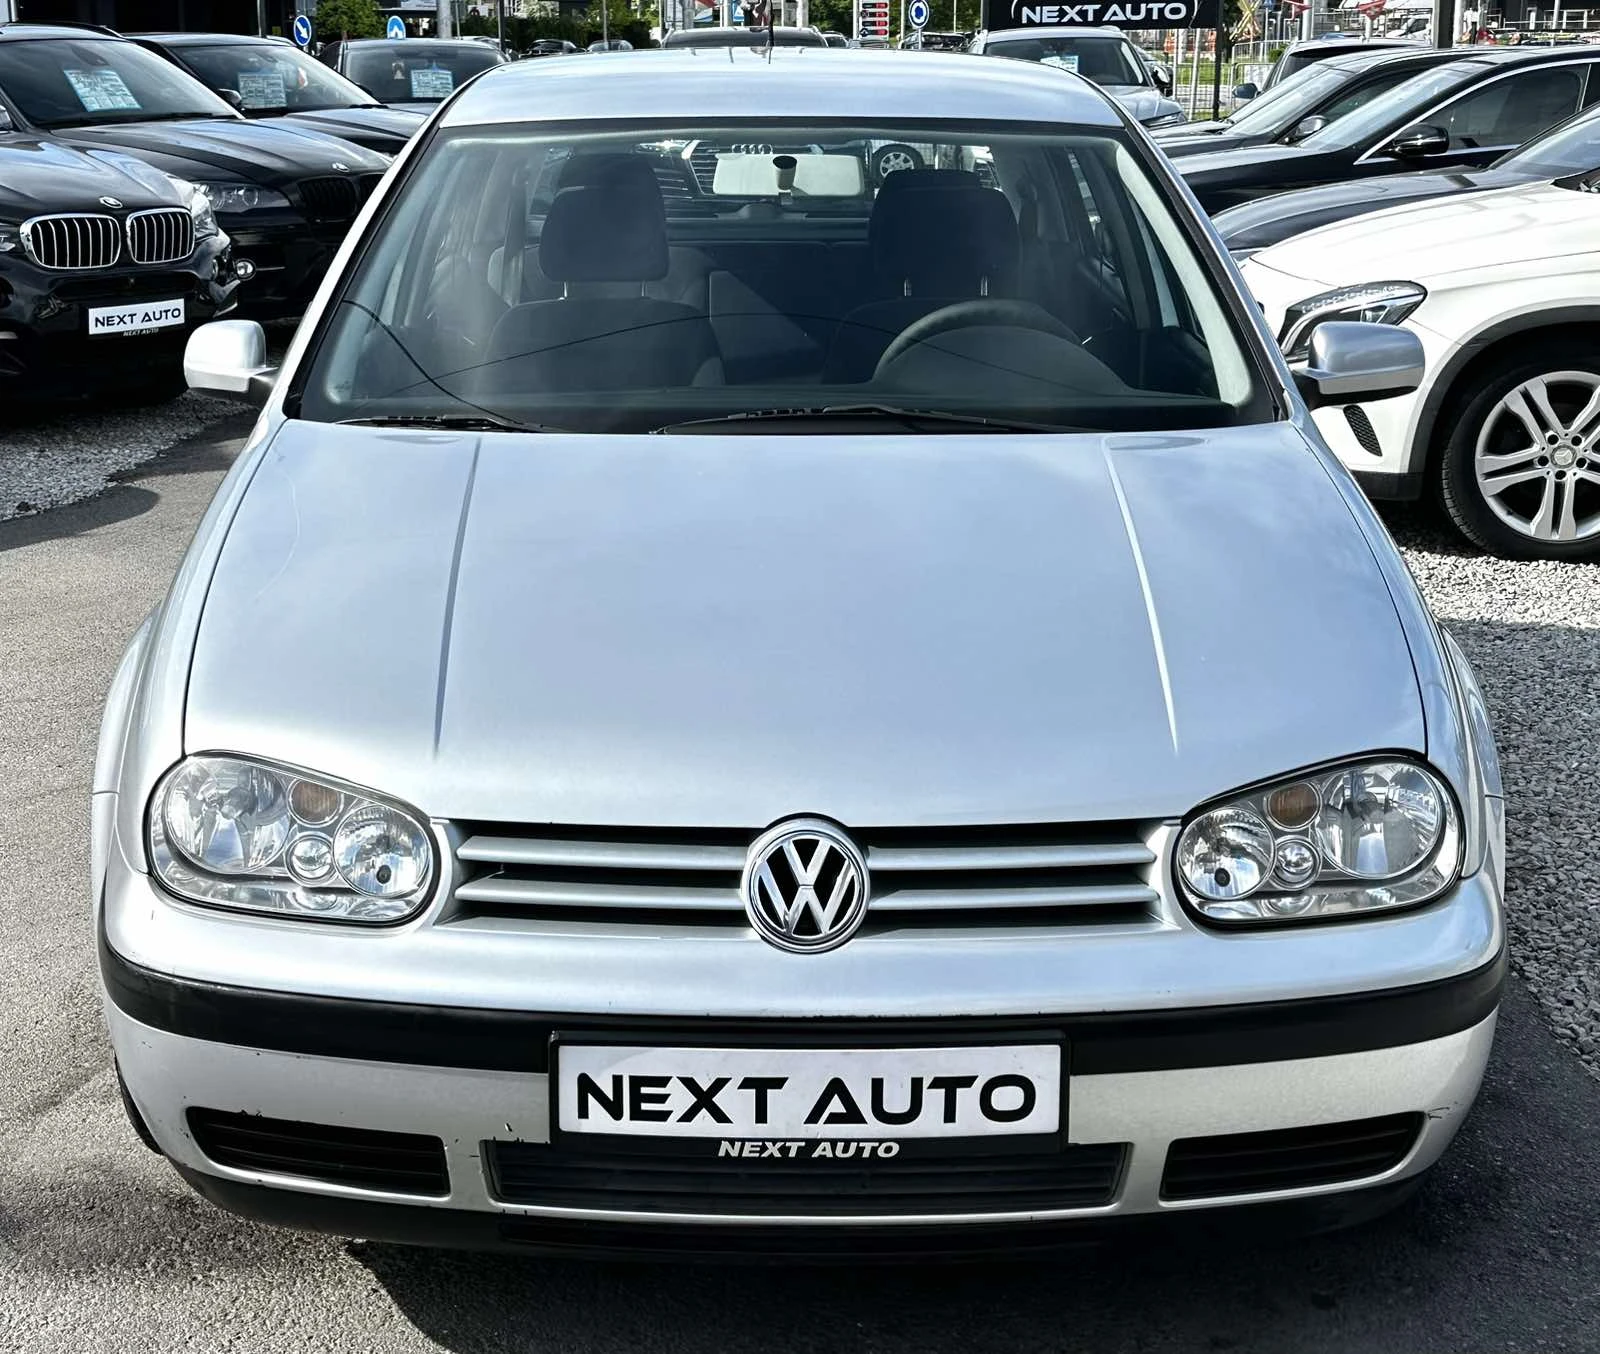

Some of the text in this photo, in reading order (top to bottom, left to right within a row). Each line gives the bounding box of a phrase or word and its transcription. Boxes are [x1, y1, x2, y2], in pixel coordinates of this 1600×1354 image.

[1021, 2, 1188, 24] NEXT AUTO
[95, 307, 182, 328] NEXT AUTO
[576, 1072, 1037, 1126] NEXT AUTO
[717, 1140, 901, 1159] NEXT AUTO
